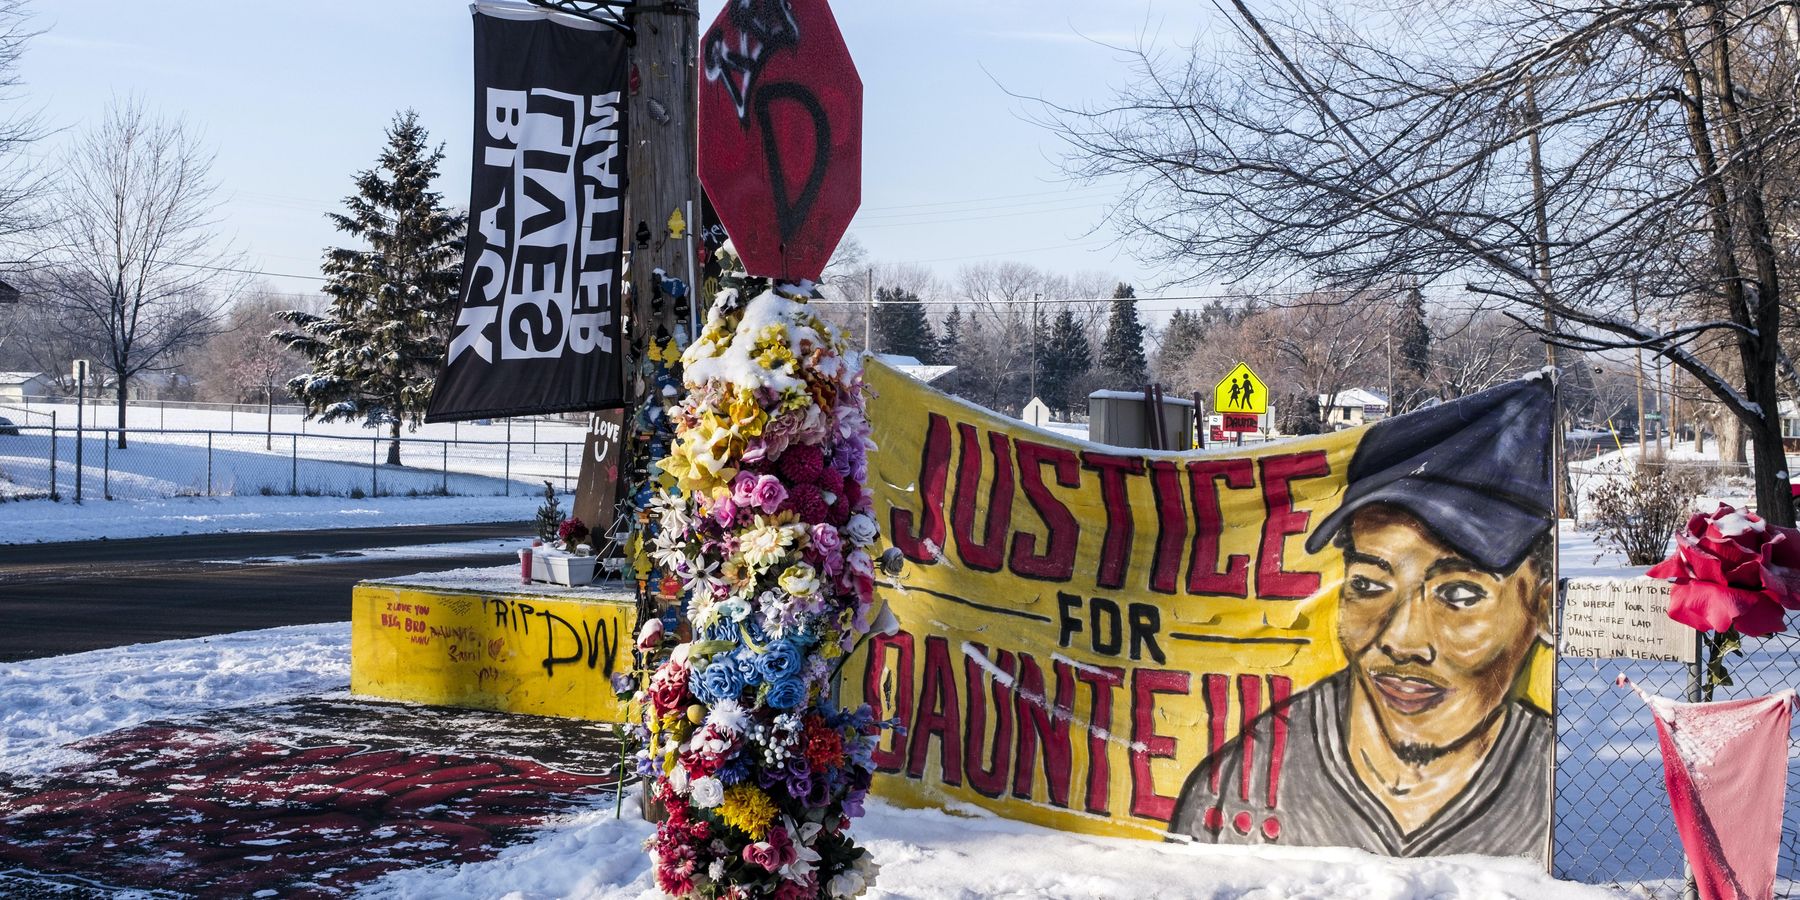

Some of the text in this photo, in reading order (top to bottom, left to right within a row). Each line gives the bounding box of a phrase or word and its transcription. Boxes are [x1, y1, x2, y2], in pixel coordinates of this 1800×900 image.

[588, 412, 620, 443] I LOVE
[594, 440, 609, 463] U
[890, 411, 1332, 600] JUSTICE
[1626, 584, 1643, 595] LAY
[1646, 585, 1658, 594] TO
[393, 602, 412, 614] LOVE
[414, 604, 430, 616] YOU
[1567, 599, 1669, 614] IS WHERE YOUR SPIR
[381, 613, 426, 633] BIG BRO
[1056, 591, 1166, 664] FOR
[1566, 612, 1652, 628] STAYS HERE LAID
[536, 610, 618, 680] DW
[1612, 632, 1664, 645] WRIGHT
[1569, 645, 1679, 662] REST IN HEAVEN
